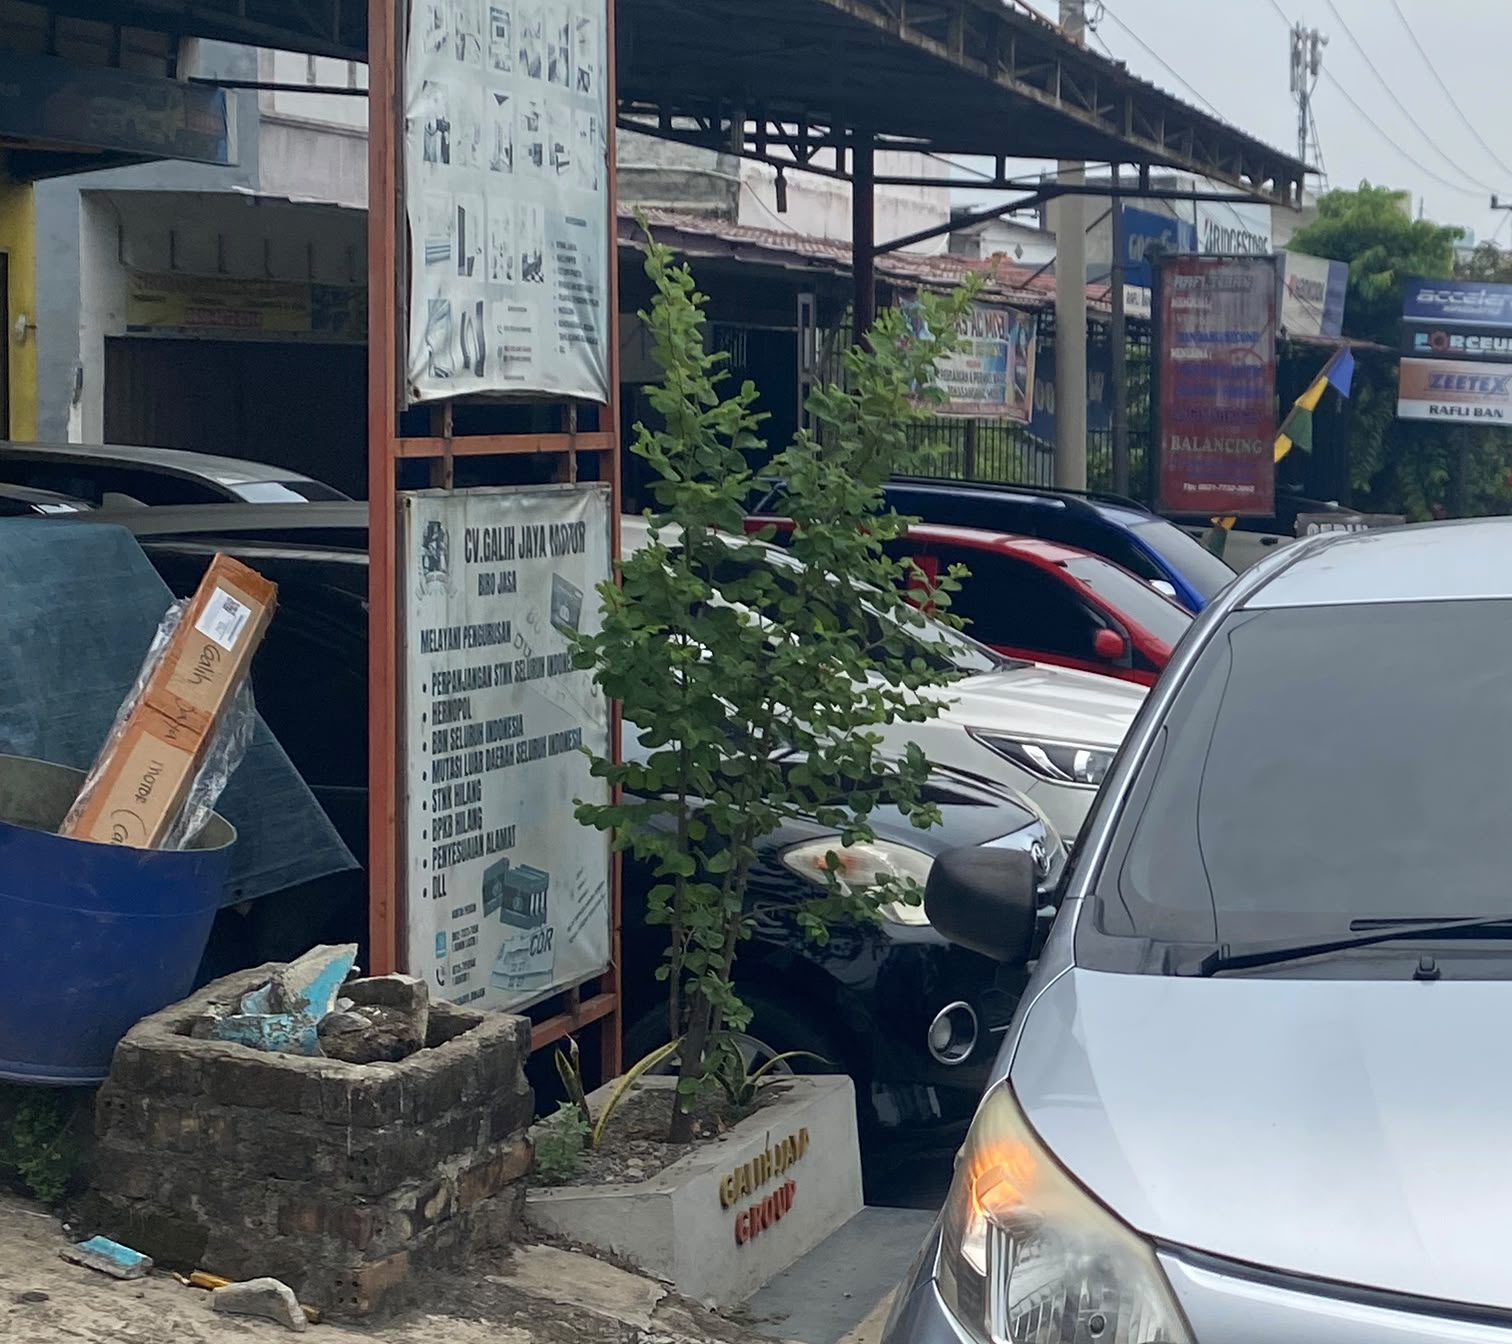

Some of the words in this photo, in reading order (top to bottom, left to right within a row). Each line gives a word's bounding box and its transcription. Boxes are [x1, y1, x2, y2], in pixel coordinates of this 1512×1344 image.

[1429, 373, 1509, 394] ZEETEX
[1429, 404, 1470, 417] RAFLI
[1474, 406, 1504, 419] BAN
[1170, 434, 1263, 455] BALANCING
[518, 524, 548, 560] JAYA
[549, 520, 586, 557] MOTOR
[478, 571, 496, 597] BIRO
[497, 569, 517, 595] JASA
[420, 625, 462, 655] MELAYANI
[462, 620, 512, 650] PENGURUSAN
[432, 664, 492, 697] PERPANJANGAN
[494, 660, 513, 687] STNK
[514, 656, 546, 684] SELURUH
[432, 728, 449, 755] BBN
[450, 722, 484, 752] SELURUH
[485, 713, 524, 744] INDONESIA
[432, 754, 463, 784] MUTASI
[464, 749, 484, 777] LUAR
[485, 743, 515, 772] DAERAH
[516, 735, 547, 765] SELURUH
[548, 727, 583, 757] INDONESIA
[432, 785, 452, 813] STNK
[454, 778, 482, 808] HILANG
[432, 814, 453, 842] BPKB
[455, 806, 483, 836] HILANG
[432, 833, 484, 871] PENYESUAIAN
[486, 823, 516, 856] ALAMAT
[432, 873, 447, 900] DLL
[734, 1178, 797, 1247] GROUP
